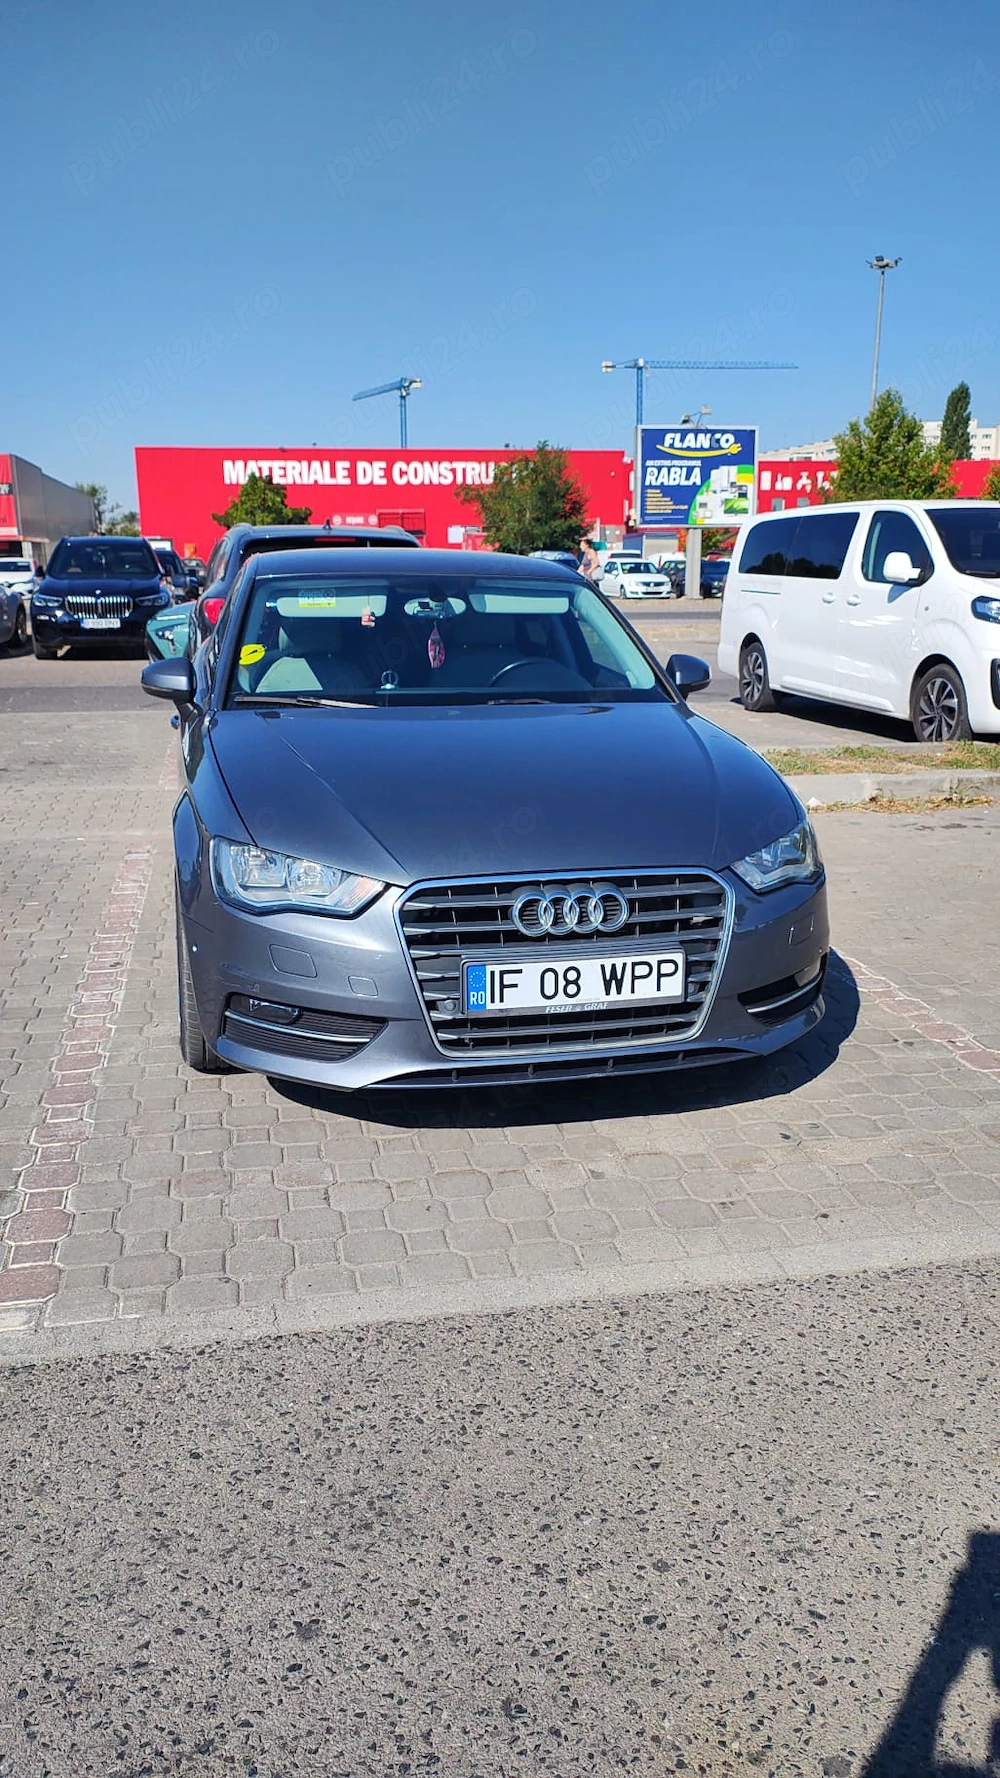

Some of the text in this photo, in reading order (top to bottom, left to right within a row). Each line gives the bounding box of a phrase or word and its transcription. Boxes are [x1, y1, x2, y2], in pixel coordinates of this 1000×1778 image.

[663, 432, 735, 449] FLANCO
[223, 460, 535, 486] MATERIALE DE CONSTRU
[644, 466, 702, 487] RABLA
[489, 958, 680, 1005] IF 08 WPP
[469, 990, 486, 1006] RO
